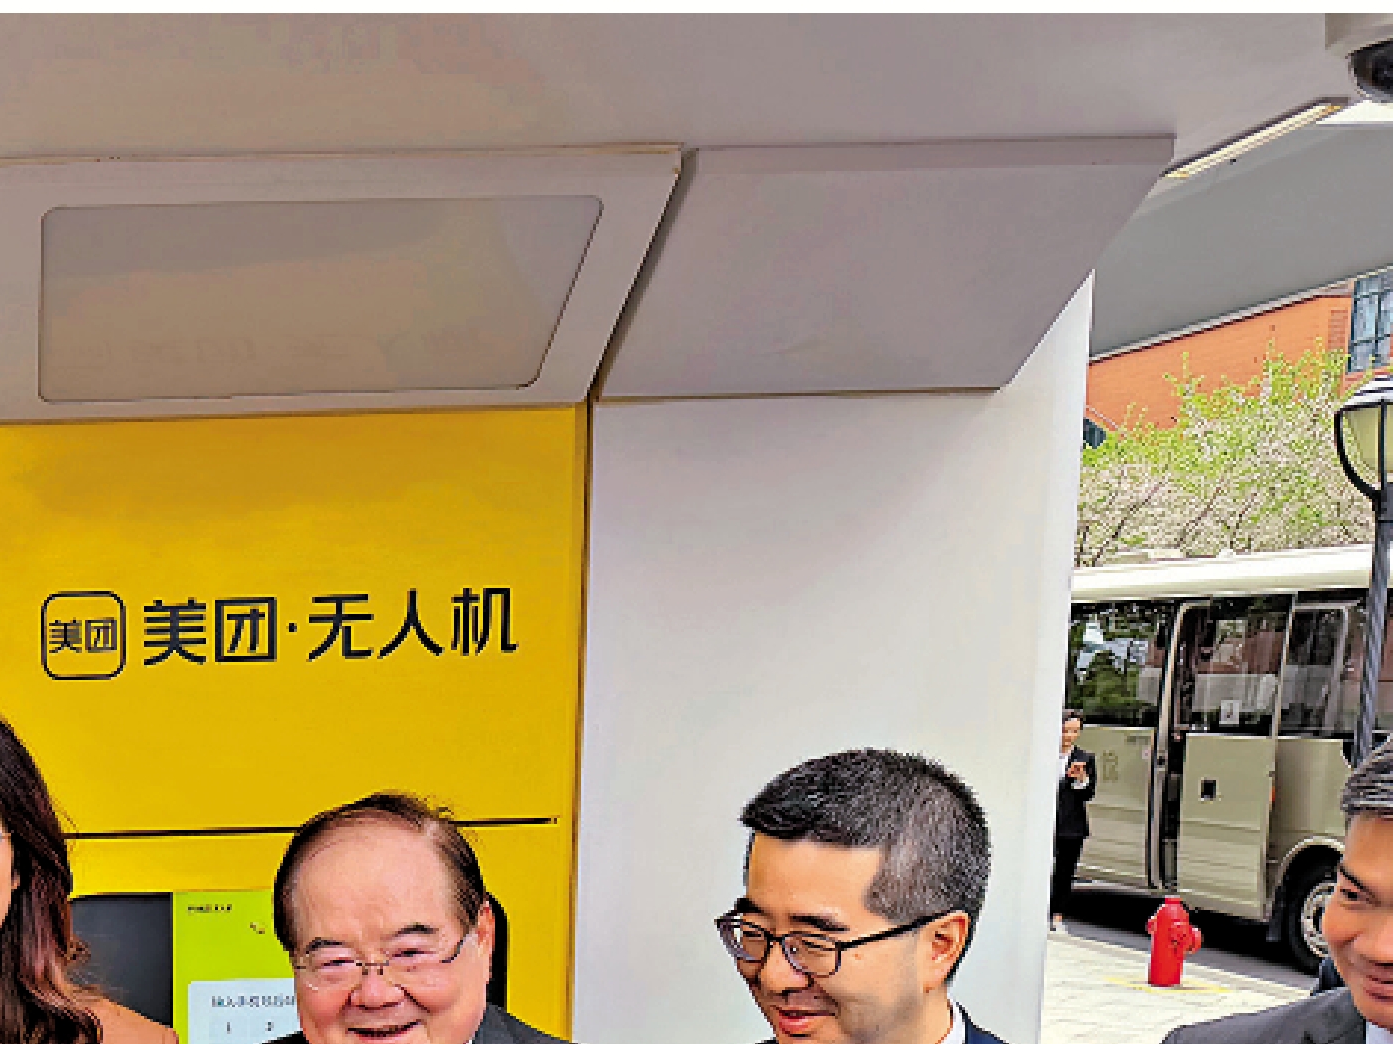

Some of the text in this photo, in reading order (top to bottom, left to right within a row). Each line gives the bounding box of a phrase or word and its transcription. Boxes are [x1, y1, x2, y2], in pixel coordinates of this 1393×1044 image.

[49, 617, 117, 653] 美团
[143, 588, 518, 666] 美团·无人机
